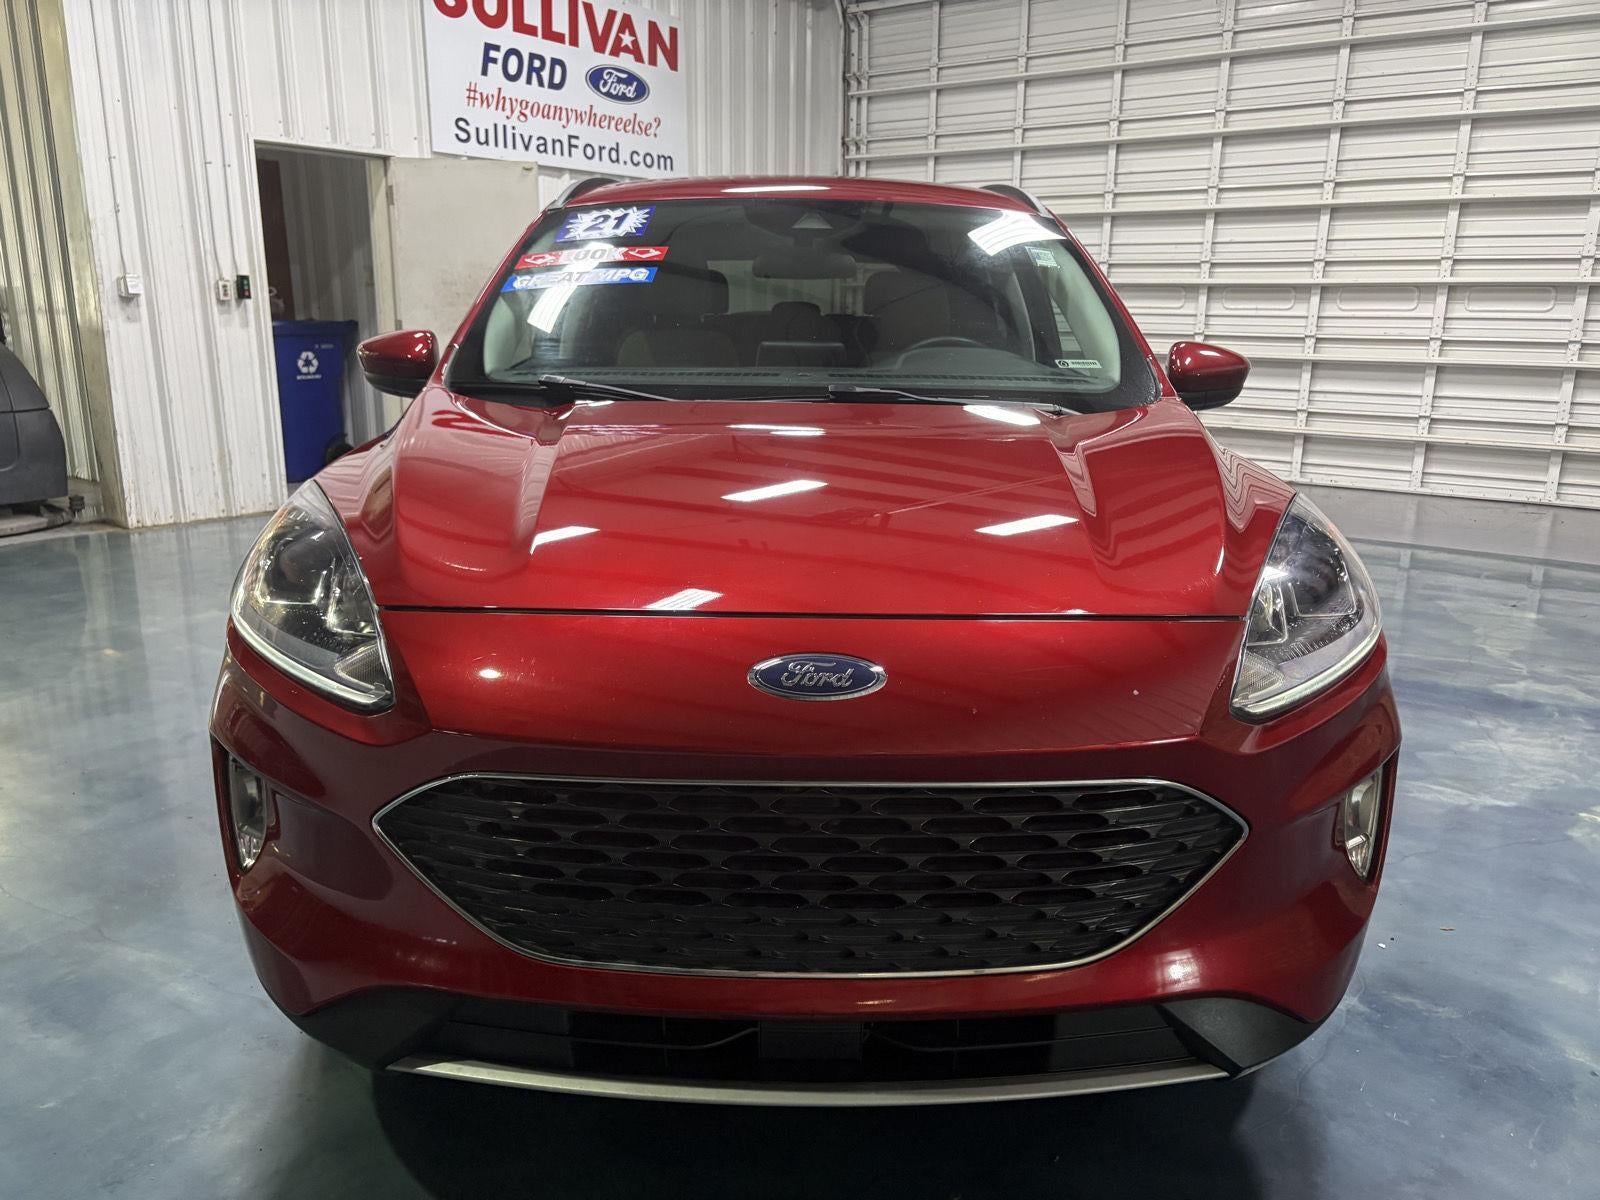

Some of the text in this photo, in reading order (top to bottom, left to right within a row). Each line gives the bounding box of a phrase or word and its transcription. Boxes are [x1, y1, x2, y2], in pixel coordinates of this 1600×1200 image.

[481, 42, 567, 91] FORD
[600, 67, 637, 100] Ford
[465, 81, 662, 138] #whygoanywhereelse?
[454, 117, 674, 172] SullivanFord.com
[582, 212, 630, 232] 21
[781, 661, 854, 687] Ford
